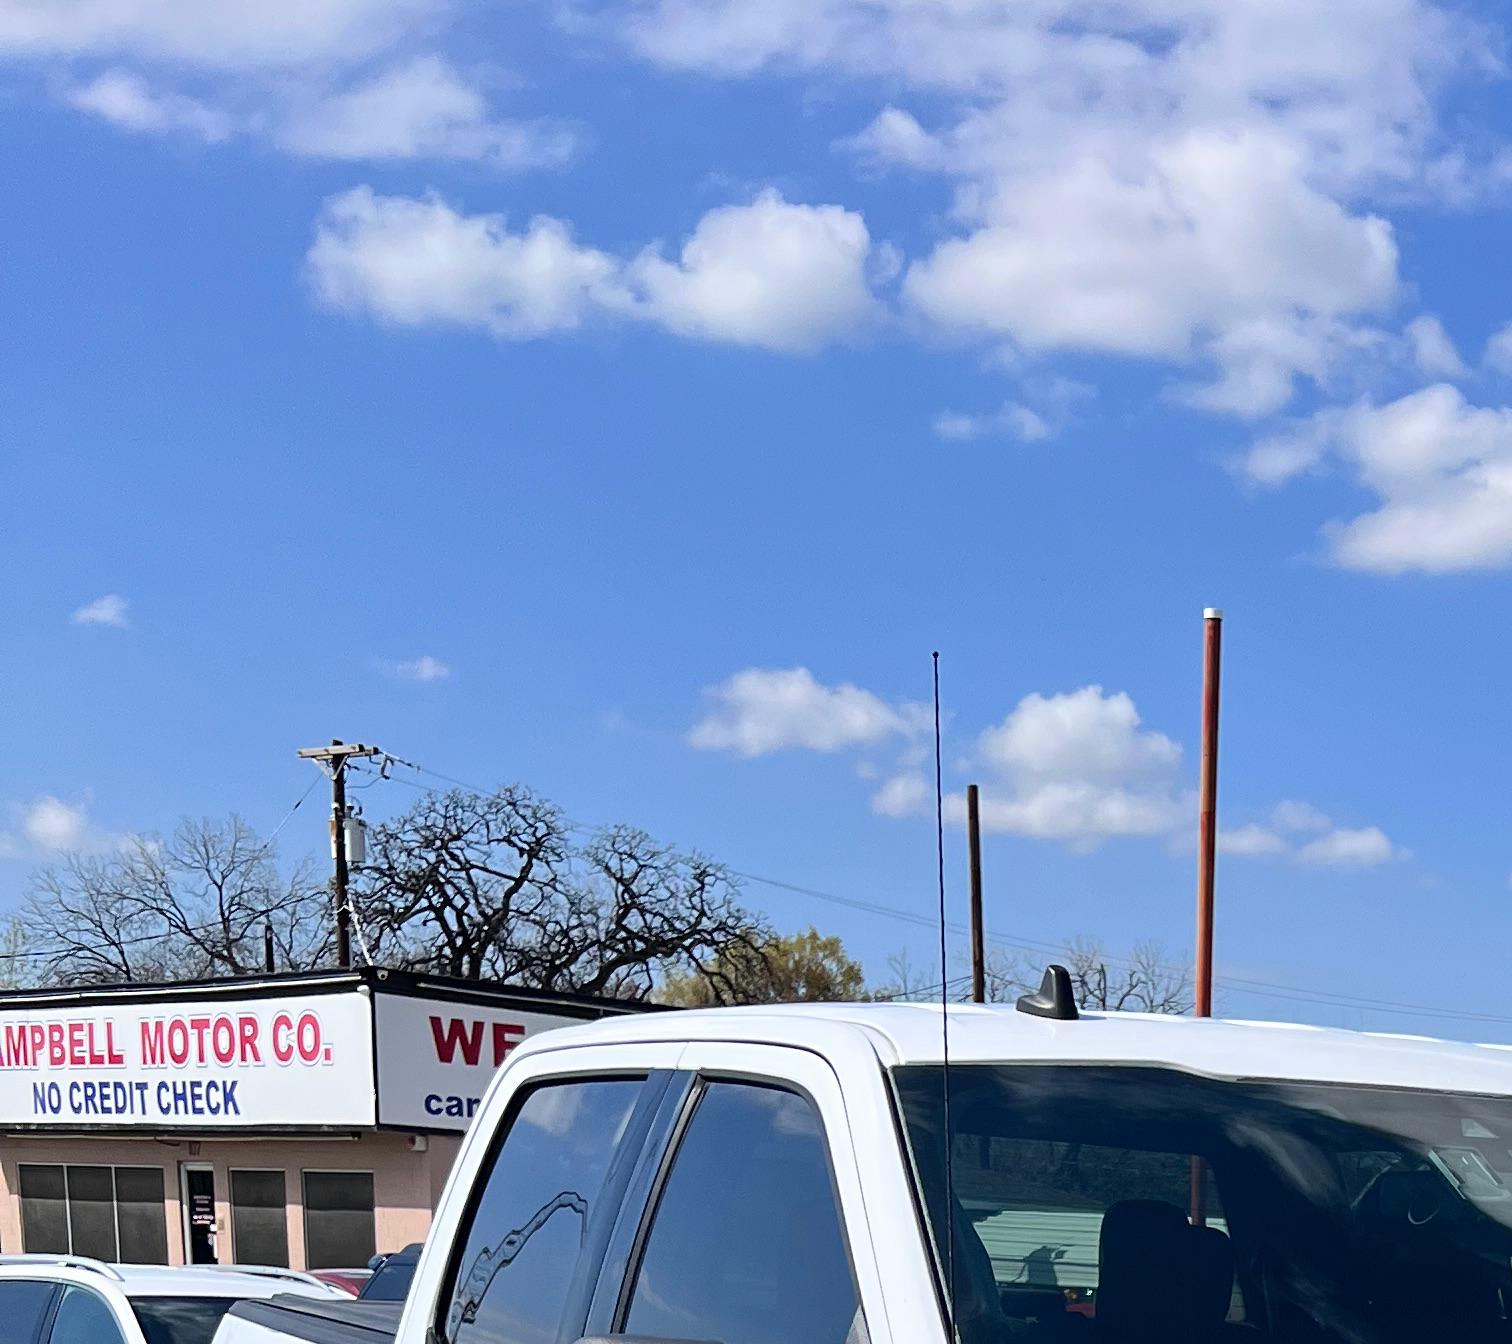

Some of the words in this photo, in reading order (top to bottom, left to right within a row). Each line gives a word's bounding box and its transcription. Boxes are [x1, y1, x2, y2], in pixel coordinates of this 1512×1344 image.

[140, 1017, 261, 1066] MOTOR
[273, 1014, 331, 1062] CO.
[33, 1081, 62, 1114] NO
[69, 1080, 149, 1115] CREDIT
[156, 1080, 240, 1115] CHECK
